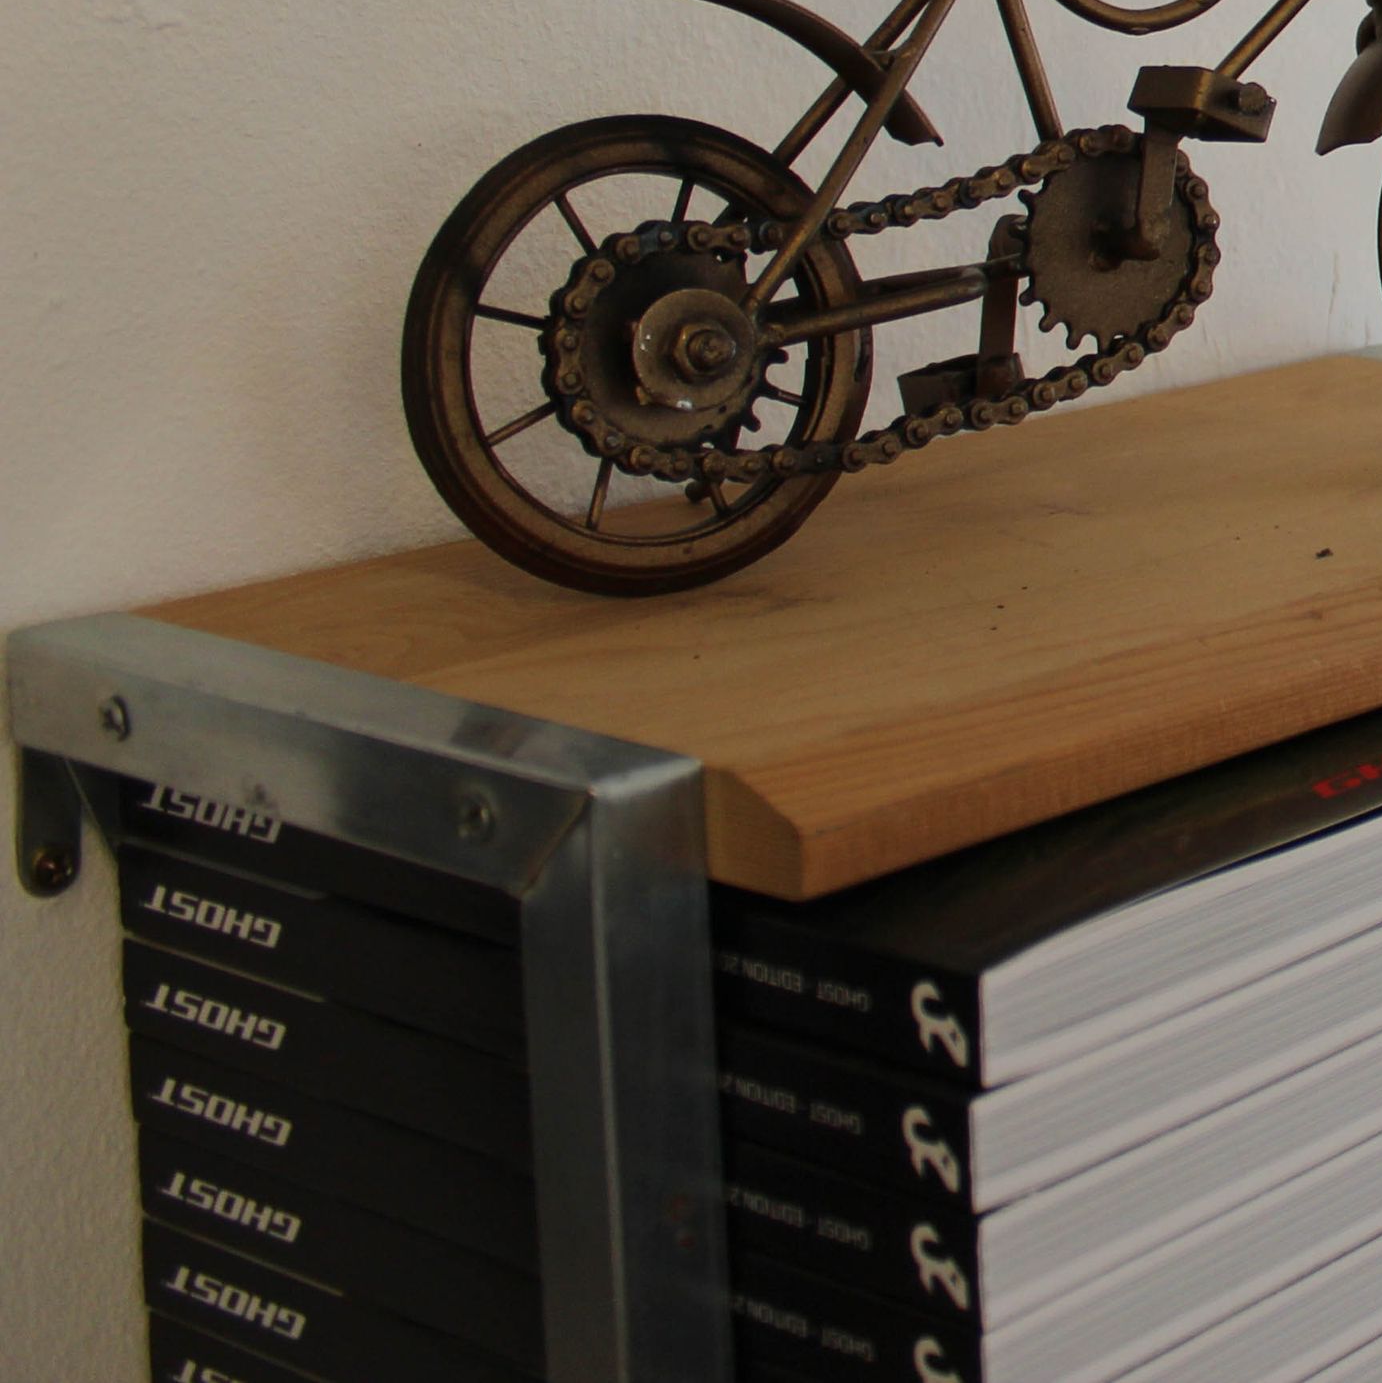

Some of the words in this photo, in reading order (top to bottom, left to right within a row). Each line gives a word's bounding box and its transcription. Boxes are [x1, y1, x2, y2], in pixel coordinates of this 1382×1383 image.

[138, 783, 282, 844] GHOST
[140, 885, 282, 948] GHOST
[742, 956, 803, 993] EDITION
[814, 979, 871, 1013] GHOST
[143, 983, 287, 1050] GHOST
[149, 1077, 292, 1147] GHOST
[735, 1075, 798, 1114] EDITION
[808, 1101, 863, 1136] GHOST
[159, 1172, 301, 1243] GHOST
[814, 1216, 871, 1252] GHOST
[164, 1266, 306, 1339] GHOST
